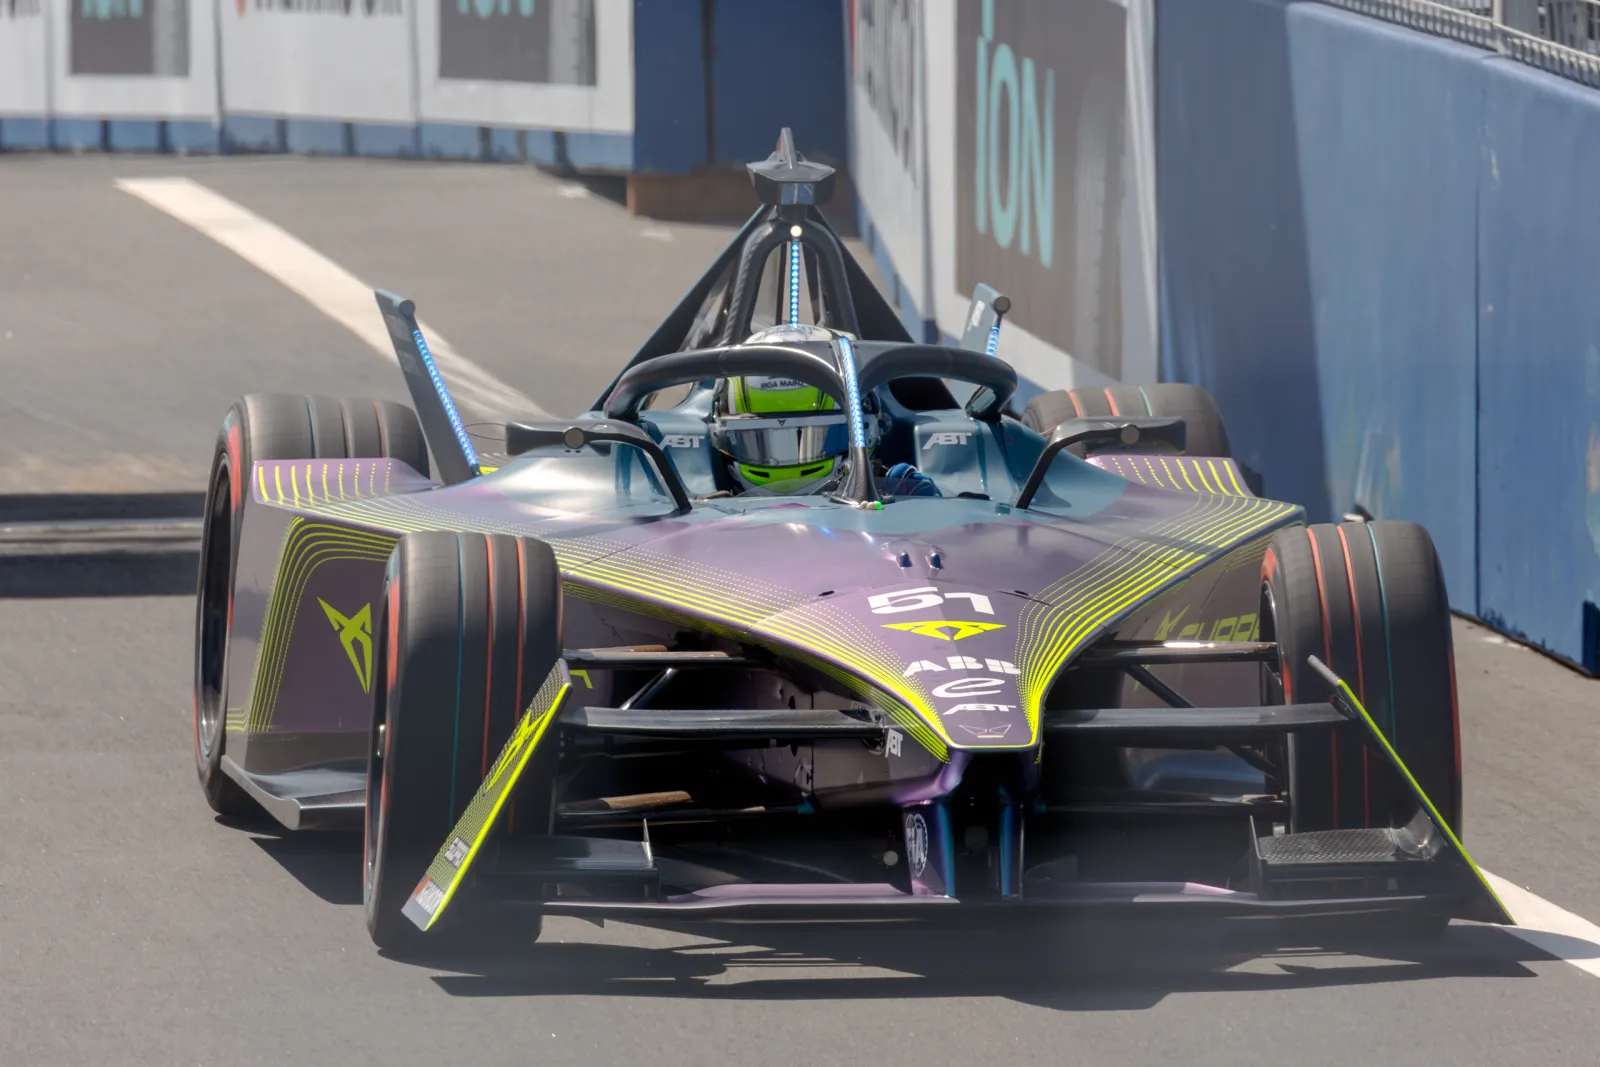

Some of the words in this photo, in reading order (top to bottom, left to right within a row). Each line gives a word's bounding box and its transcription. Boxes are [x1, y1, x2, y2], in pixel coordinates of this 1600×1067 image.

[658, 434, 705, 450] ABT
[922, 432, 973, 450] ABT
[867, 586, 995, 615] 51
[901, 655, 1022, 677] ABB
[942, 703, 1017, 716] ABT
